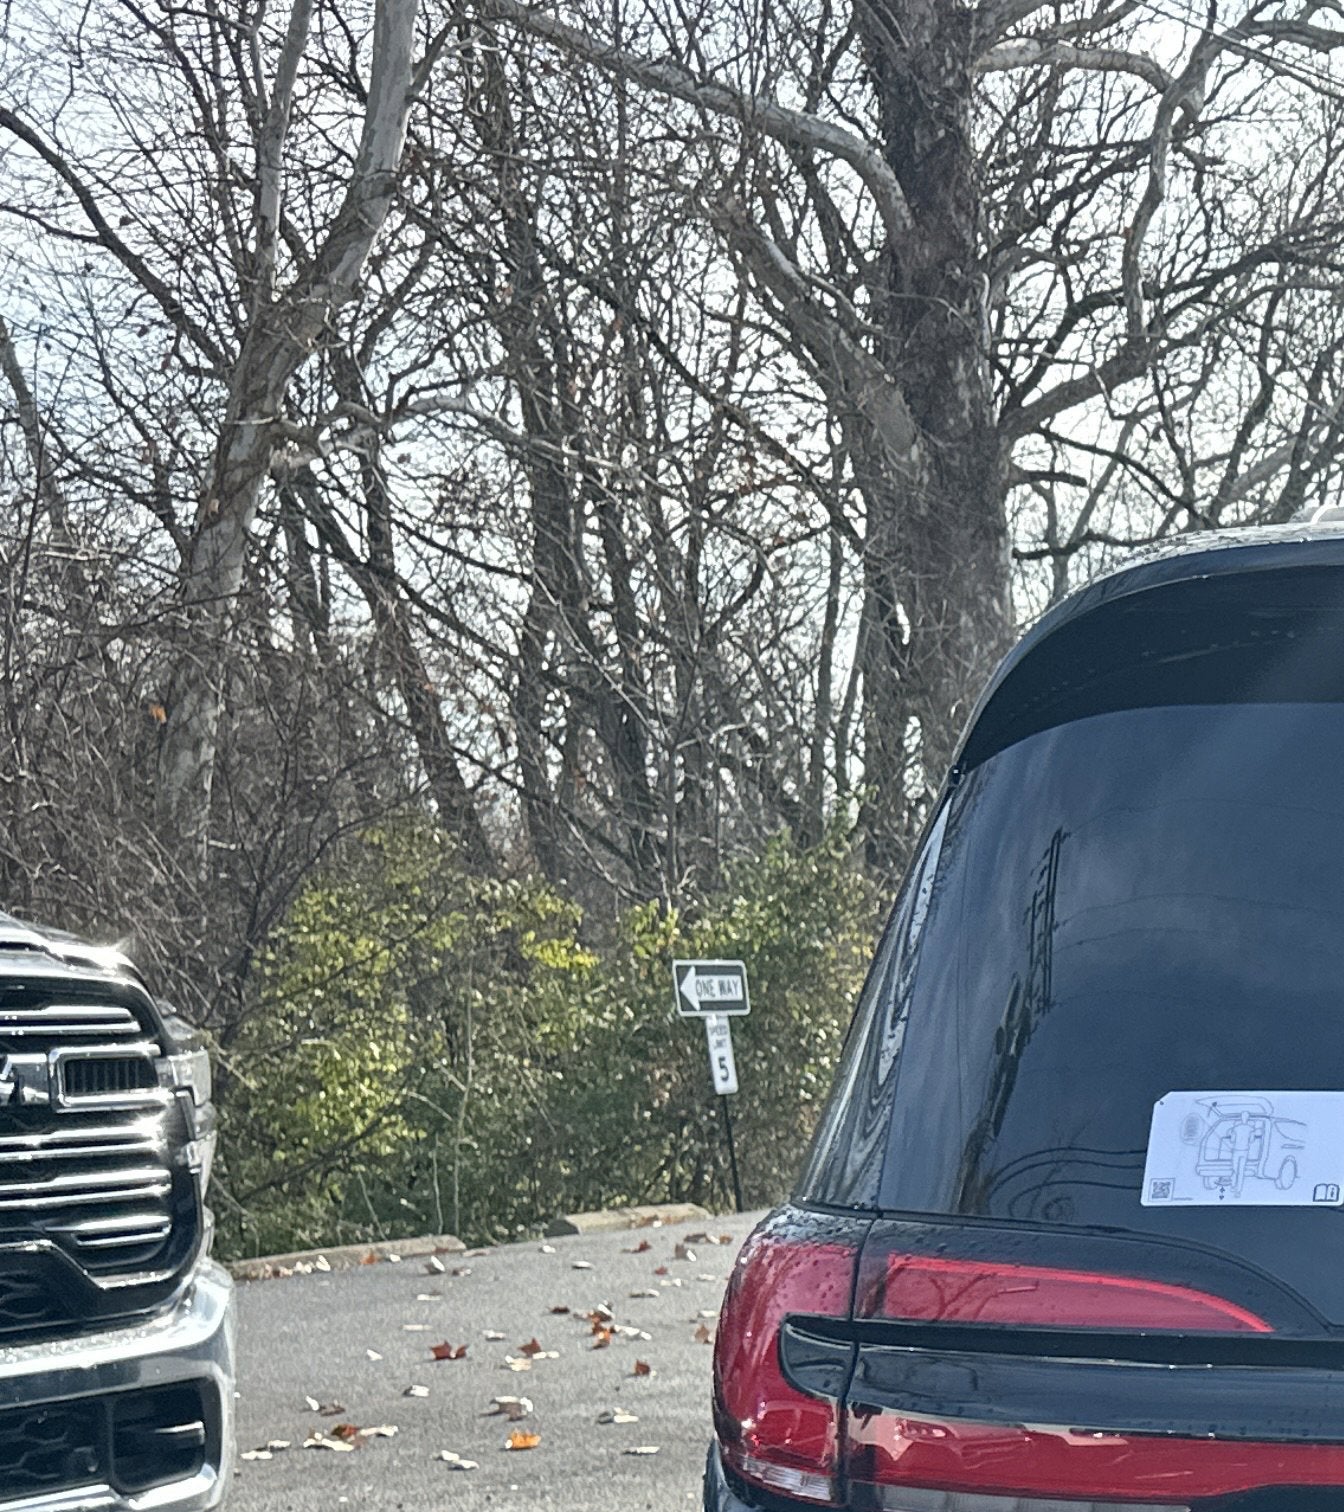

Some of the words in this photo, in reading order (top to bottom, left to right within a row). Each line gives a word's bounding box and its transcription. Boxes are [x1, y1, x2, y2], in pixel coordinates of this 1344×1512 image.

[696, 979, 716, 997] ONE
[718, 979, 739, 996] WAY
[718, 1056, 730, 1082] 5
